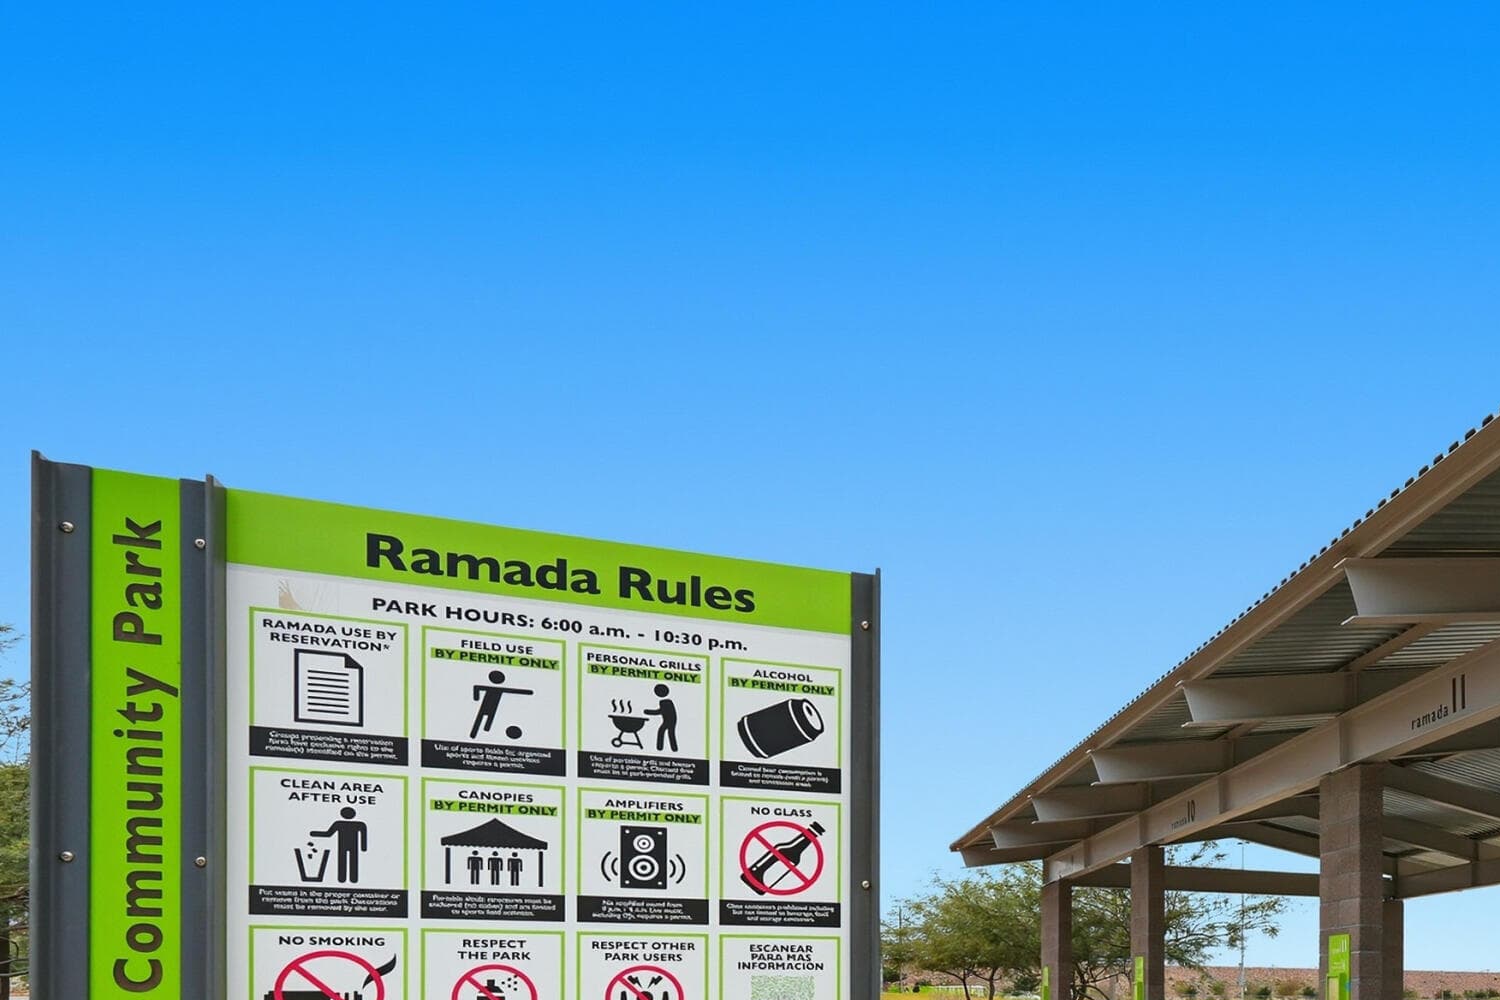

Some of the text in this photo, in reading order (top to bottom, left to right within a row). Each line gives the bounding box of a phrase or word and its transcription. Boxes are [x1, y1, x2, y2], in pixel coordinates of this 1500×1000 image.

[365, 531, 755, 613] Ramada Rules
[112, 516, 163, 646] Park
[262, 617, 397, 641] RAMADA USE BY
[372, 596, 437, 618] PARK
[445, 605, 534, 628] HOURS:
[540, 616, 583, 634] 6:00
[588, 624, 630, 639] a.m.
[654, 629, 702, 646] 10:30
[707, 637, 747, 651] p.m.
[460, 638, 533, 655] FIELD USE
[434, 649, 558, 670] BY PERMIT ONLY
[586, 651, 701, 672] PERSONAL GRILLS
[590, 664, 698, 683] BY PERMIT ONLY
[752, 668, 813, 683] ALCOHOL
[730, 677, 834, 696] BY PERMIT ONLY
[1411, 704, 1449, 730] ramada
[279, 777, 384, 794] CLEAN AREA
[287, 791, 376, 805] AFTER USE
[457, 789, 534, 803] CANOPIES
[433, 799, 557, 816] BY PERMIT ONLY
[604, 798, 684, 812] AMPLIFIERS
[750, 806, 812, 818] NO GLASS
[1187, 799, 1196, 823] 10
[587, 809, 701, 824] BY PERMIT ONLY
[113, 666, 179, 993] Community
[278, 935, 385, 947] NO SMOKING
[462, 938, 527, 949] RESPECT
[591, 940, 695, 951] RESPECT OTHER
[749, 943, 813, 953] ESCANEAR
[456, 950, 531, 960] THE PARK
[604, 952, 683, 962] PARK USERS
[750, 953, 783, 961] PARA
